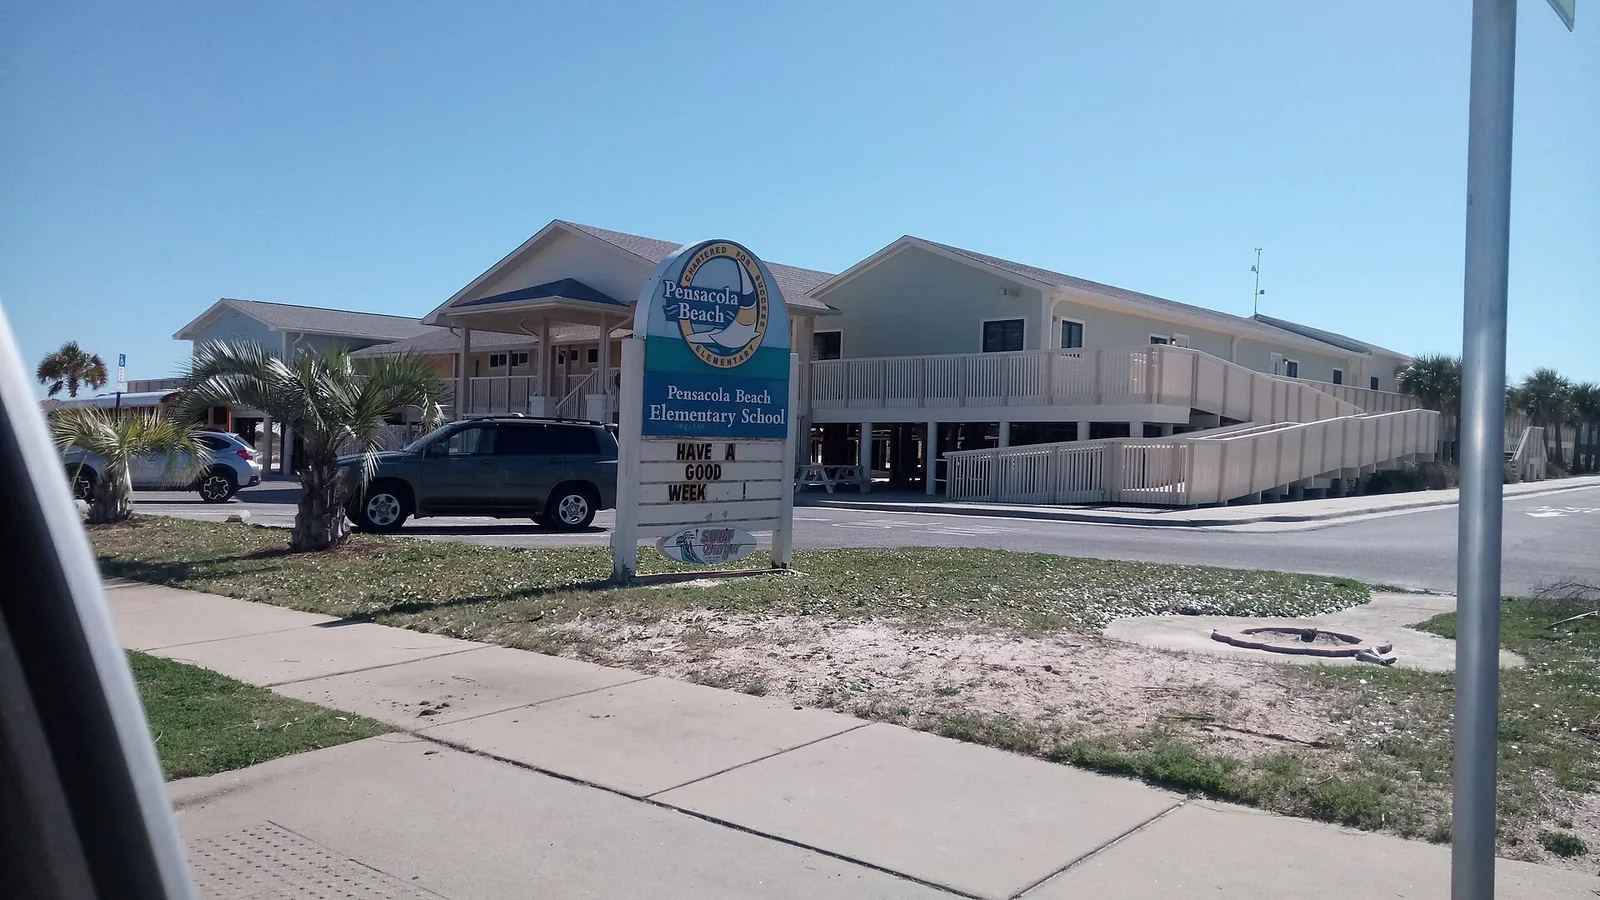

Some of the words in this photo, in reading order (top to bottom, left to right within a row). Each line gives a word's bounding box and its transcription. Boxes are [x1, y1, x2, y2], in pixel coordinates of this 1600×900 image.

[664, 280, 739, 306] Pensacola
[685, 247, 727, 282] CHARTERED
[736, 251, 751, 267] FOR
[755, 275, 767, 328] SUCCESS
[678, 302, 724, 323] Beach
[695, 344, 754, 366] ELEMENTARY
[667, 385, 730, 402] Pensacola
[735, 389, 771, 404] Beach
[649, 404, 736, 427] Elementary
[741, 408, 785, 425] School
[676, 443, 712, 461] HAVE
[725, 443, 736, 461] A
[685, 463, 722, 481] GOOD
[668, 484, 706, 501] WEEK
